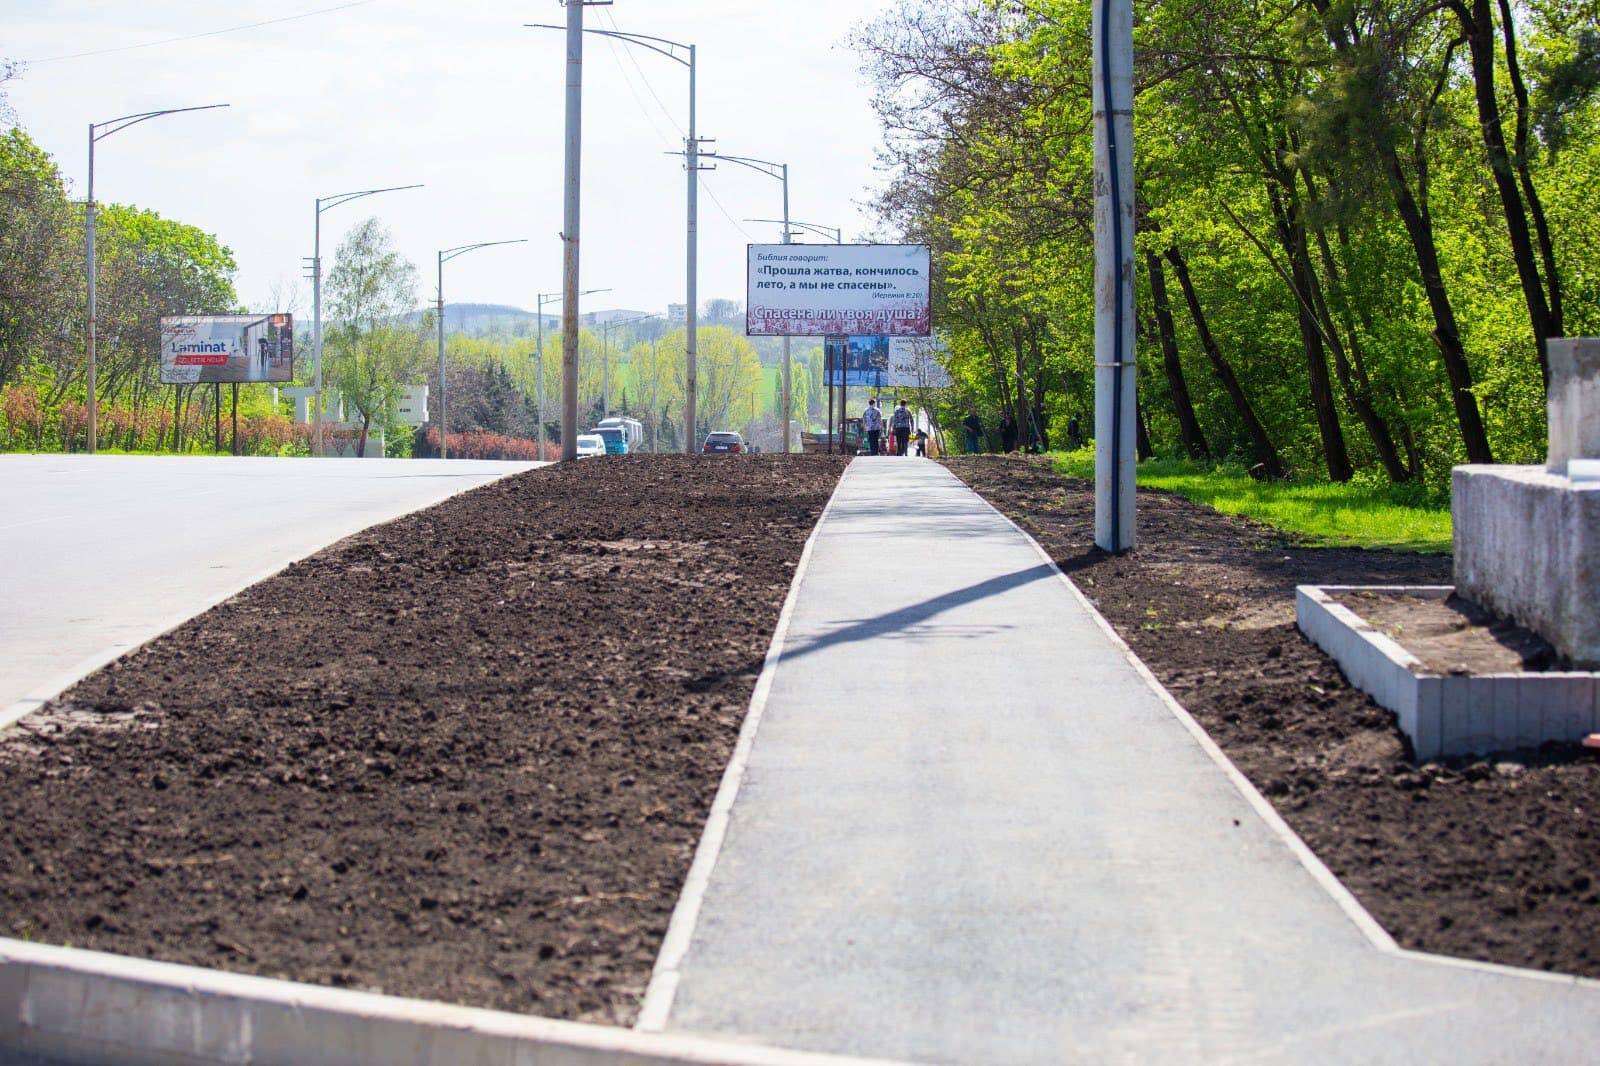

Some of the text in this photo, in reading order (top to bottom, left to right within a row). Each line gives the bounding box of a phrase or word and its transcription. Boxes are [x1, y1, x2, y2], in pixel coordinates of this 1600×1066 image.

[757, 252, 829, 263] Библия говорит:
[757, 265, 919, 277] «Прошла жатва, кончилось
[757, 280, 897, 291] лето, а мы не спасены».
[754, 305, 923, 322] Спасена ли твоя душа?
[172, 340, 226, 352] Laminat
